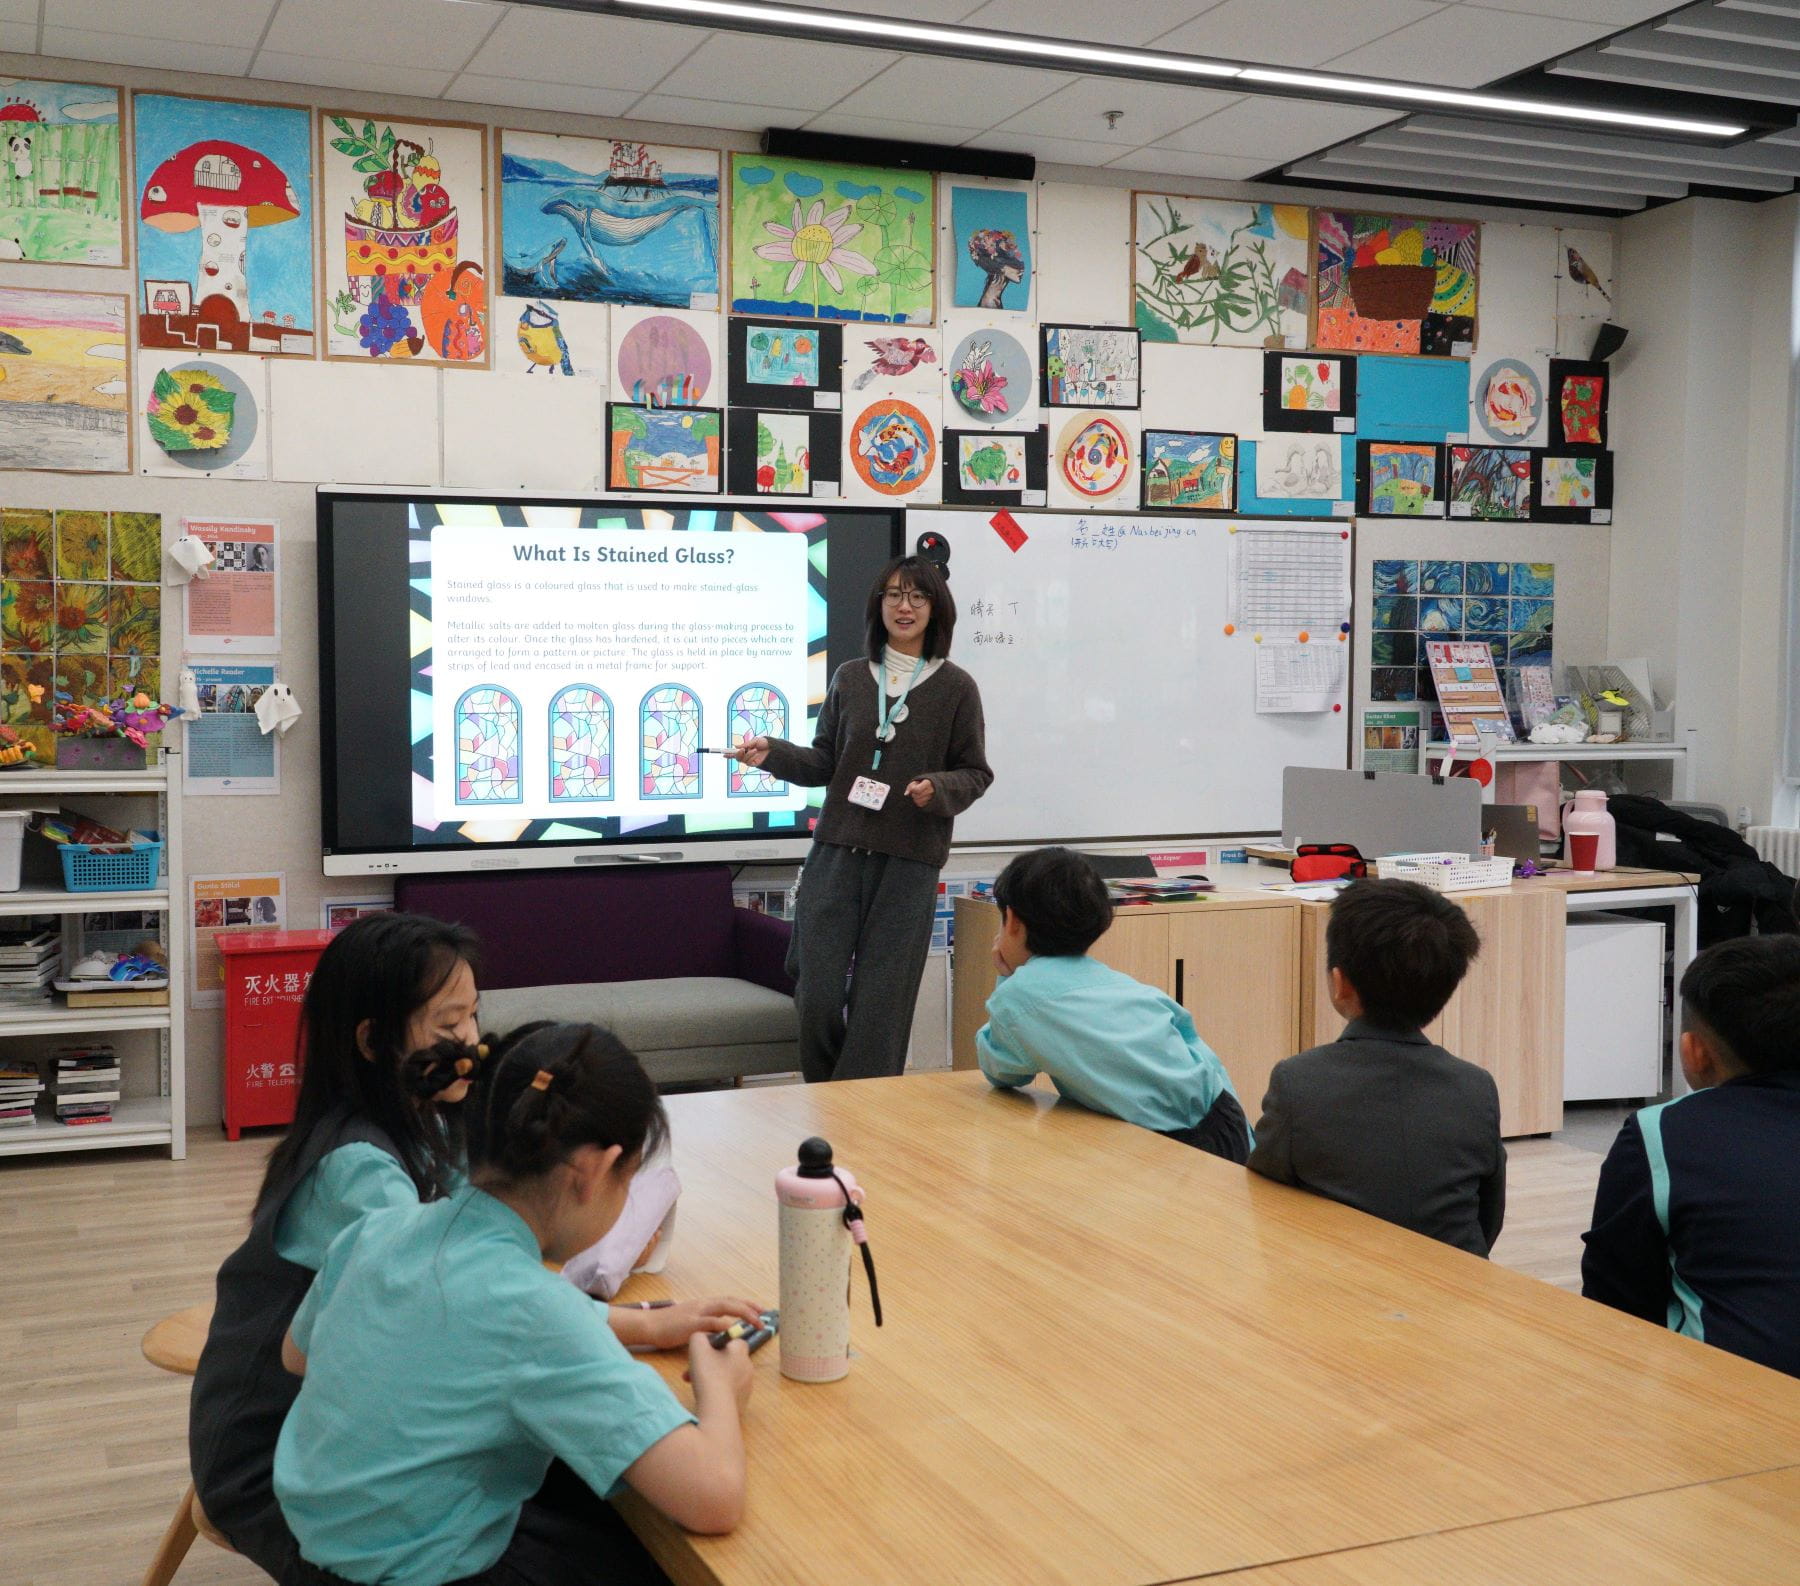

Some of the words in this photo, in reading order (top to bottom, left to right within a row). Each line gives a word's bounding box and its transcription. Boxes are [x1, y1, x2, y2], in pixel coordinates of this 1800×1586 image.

[513, 544, 566, 561] What
[573, 547, 590, 561] Is
[597, 546, 668, 563] Stained
[676, 547, 734, 564] Glass?
[448, 581, 482, 590] Stained
[487, 581, 512, 591] glass
[535, 582, 574, 590] coloured
[578, 582, 600, 592] glass
[605, 582, 622, 590] that
[638, 582, 657, 590] used
[674, 583, 696, 591] make
[448, 621, 485, 630] Metallic
[490, 621, 511, 630] salts
[533, 621, 560, 629] added
[578, 622, 608, 630] molten
[613, 622, 635, 632] glass
[639, 622, 668, 632] during
[751, 624, 782, 634] process
[525, 635, 547, 643] Once
[570, 635, 592, 645] glass
[722, 637, 747, 645] pieces
[751, 635, 776, 643] which
[448, 648, 491, 659] arranged
[508, 647, 529, 658] form
[543, 649, 578, 659] pattern
[651, 648, 673, 658] glass
[688, 648, 705, 656] held
[721, 648, 743, 659] place
[448, 663, 474, 672] strips
[491, 661, 509, 670] lead
[626, 661, 652, 672] frame
[244, 997, 260, 1007] FIRE
[245, 1062, 275, 1080] 火警
[246, 1080, 264, 1088] FIRE
